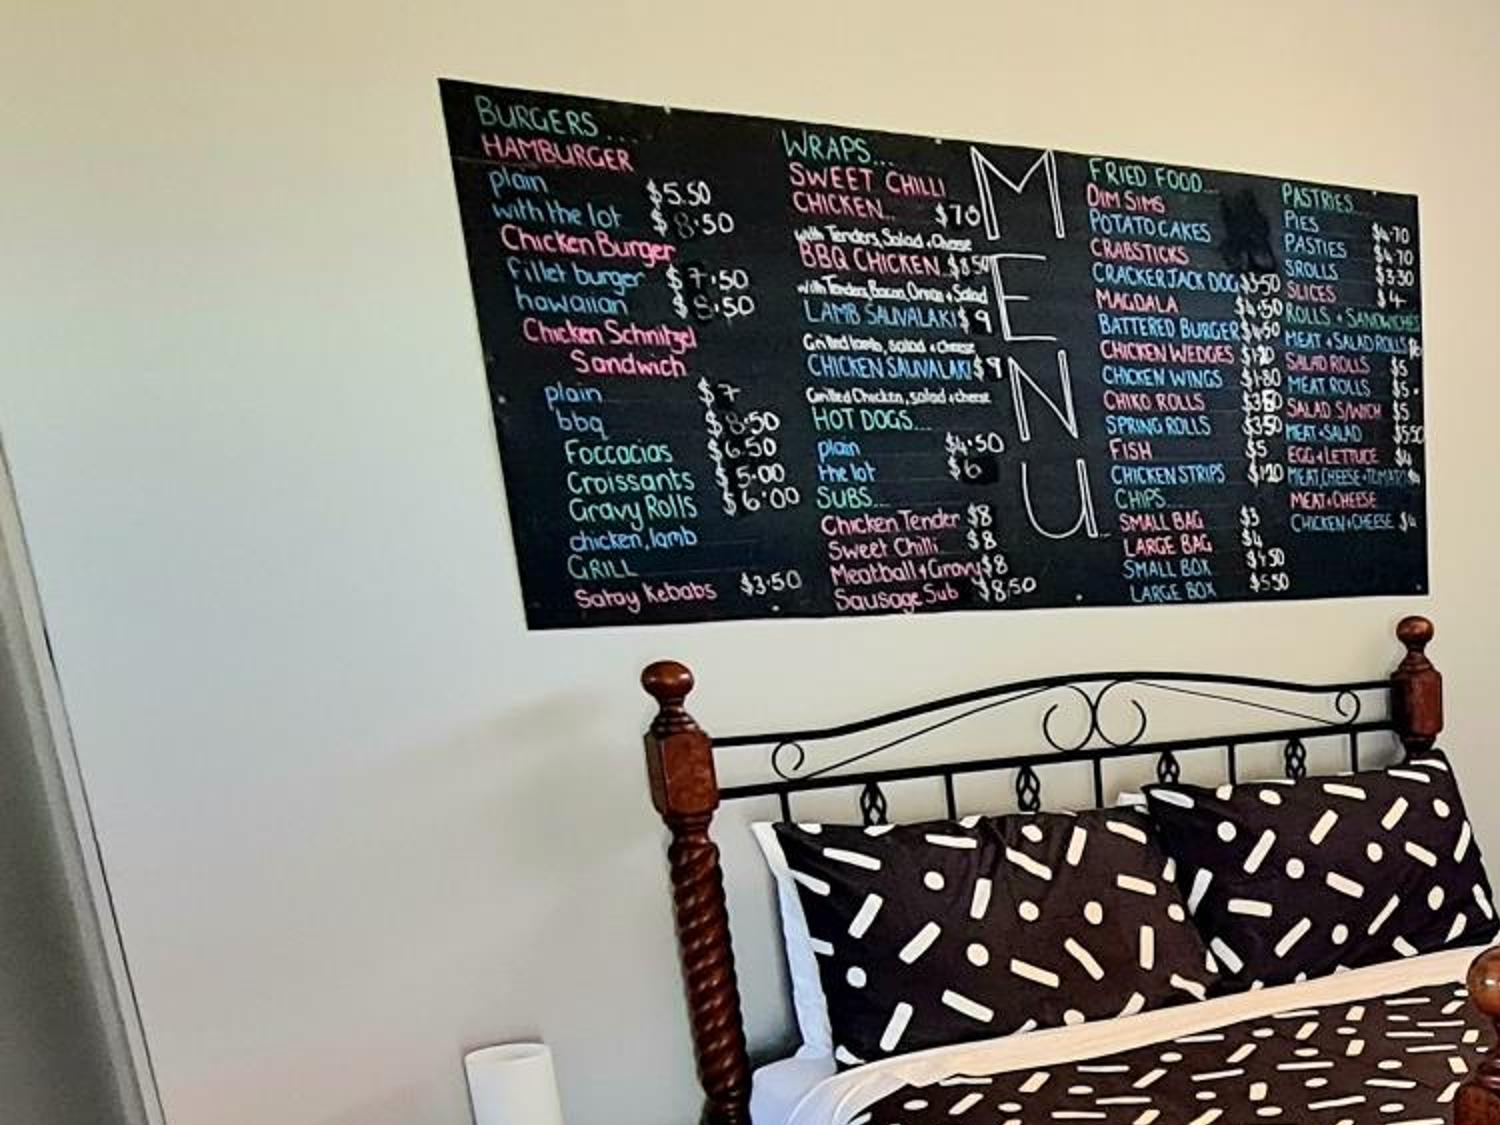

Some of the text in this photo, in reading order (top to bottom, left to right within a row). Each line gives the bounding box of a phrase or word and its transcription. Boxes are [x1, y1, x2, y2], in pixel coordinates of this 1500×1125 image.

[481, 134, 634, 173] HAMBURGER
[488, 169, 548, 197] plain
[789, 162, 946, 199] SWEET CHILLI
[1089, 157, 1147, 187] FRIED
[1087, 182, 1165, 214] DIM SIMS
[492, 202, 543, 222] with
[547, 201, 582, 225] the
[588, 202, 622, 228] lot
[1089, 208, 1211, 243] POTATO CAKES
[1285, 210, 1320, 233] PIES
[500, 223, 676, 268] Chicken Burger
[1090, 238, 1189, 265] CRABSTICKS
[1285, 233, 1347, 259] PASTIES
[799, 242, 941, 277] BBQ CHICKEN
[507, 255, 568, 283] fillet
[573, 260, 645, 296] burger
[1208, 271, 1238, 292] DOG
[516, 287, 629, 315] hawaiian
[1096, 288, 1179, 313] MAGDALA
[1287, 280, 1336, 303] SLICES
[803, 299, 861, 324] LAMB
[1286, 303, 1331, 325] ROLLS
[522, 318, 603, 345] Chicken
[1098, 313, 1175, 338] BATTERED
[1180, 317, 1240, 341] BURGER
[1100, 339, 1234, 364] CHICKEN WEDGES
[1285, 331, 1321, 349] MEAT
[1334, 332, 1374, 351] SALAD
[570, 350, 687, 377] Sandwich
[807, 354, 885, 379] CHICKEN
[1286, 352, 1330, 372] SALAD
[1332, 355, 1371, 374] ROLLS
[1102, 365, 1165, 386] CHICKEN
[1169, 369, 1223, 388] WINGS
[1288, 376, 1327, 395] MEAT
[1330, 378, 1371, 397] ROLLS
[545, 381, 603, 411] plain
[1104, 390, 1205, 412] CHIKO ROLLS
[1286, 398, 1331, 419] SALAD
[812, 405, 855, 431] HOT
[1105, 415, 1162, 435] SPRING
[1166, 416, 1211, 435] ROLLS
[1285, 423, 1320, 442] MEAT
[1324, 425, 1363, 443] SALAD
[564, 439, 673, 465] Foccacias
[817, 438, 860, 464] plain
[1109, 438, 1152, 460] FISH
[1288, 445, 1378, 464] EGG LETTUCE
[567, 467, 695, 496] Croissants
[849, 461, 876, 483] lot
[1111, 464, 1226, 485] CHICKEN STRIPS
[1290, 490, 1376, 509] MEAT CHEESE
[569, 498, 644, 532] Gravy
[645, 494, 698, 519] Rolls
[821, 503, 992, 536] Chicken Tender $8
[1119, 512, 1170, 532] SMALL
[1172, 510, 1204, 529] BAG
[1290, 514, 1345, 532] CHICKEN
[829, 530, 997, 561] Sweet Chilli $8
[1123, 537, 1176, 557] LARGE
[1180, 534, 1213, 555] BAG
[567, 554, 640, 580] GRILL
[831, 561, 918, 586] Meatball
[1123, 558, 1213, 579] SMALL BOX
[574, 569, 802, 614] Satay Kebabs $3.50
[833, 589, 923, 616] Sausage
[923, 583, 959, 603] Sub
[1130, 585, 1182, 603] LARGE
[1185, 582, 1216, 598] BOX
